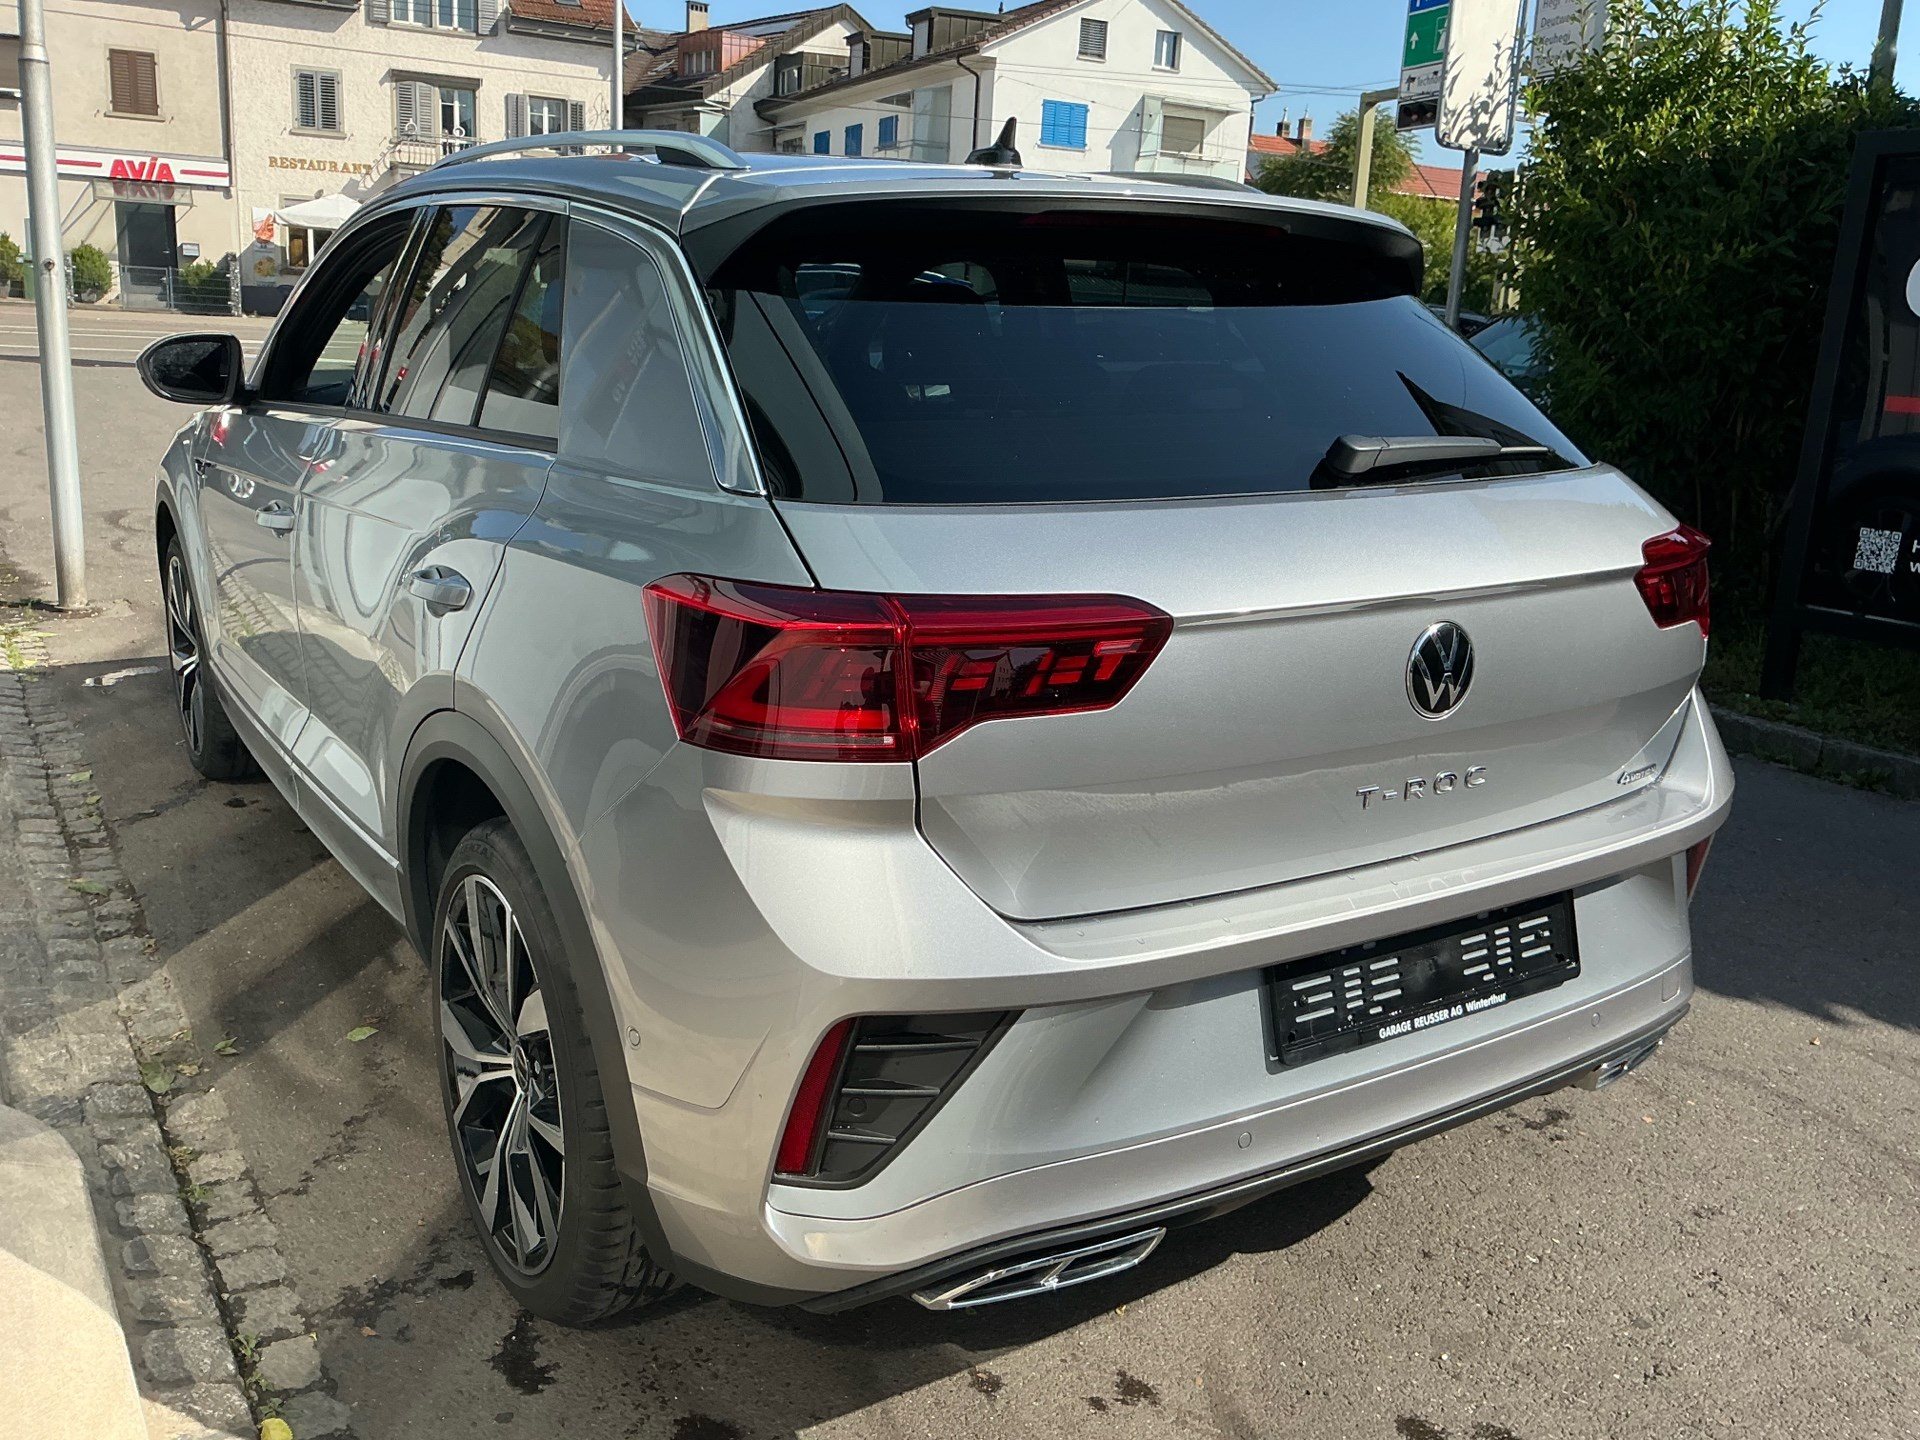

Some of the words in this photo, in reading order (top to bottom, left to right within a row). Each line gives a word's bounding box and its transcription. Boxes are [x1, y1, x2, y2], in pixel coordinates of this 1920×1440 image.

[1538, 30, 1571, 46] euhegi
[268, 156, 373, 175] RESTAURANT
[1356, 765, 1486, 810] T-ROC
[1379, 1019, 1412, 1038] GARAGE
[1414, 1010, 1449, 1028] REUSSER
[1450, 1004, 1463, 1018] AG
[1465, 992, 1507, 1012] Winterthur
